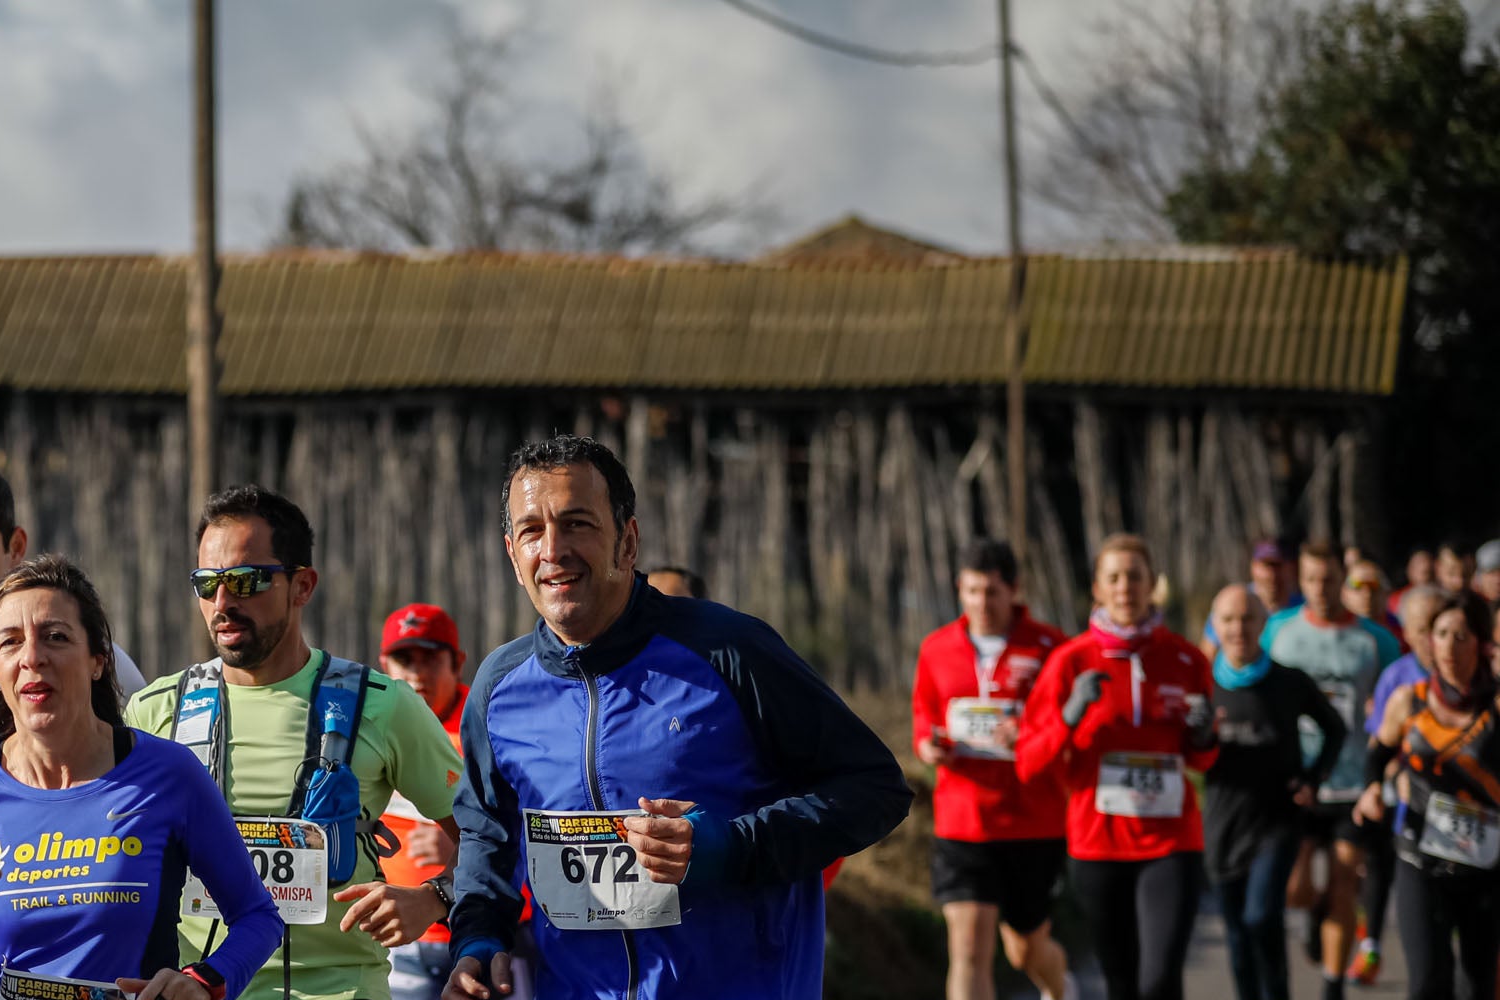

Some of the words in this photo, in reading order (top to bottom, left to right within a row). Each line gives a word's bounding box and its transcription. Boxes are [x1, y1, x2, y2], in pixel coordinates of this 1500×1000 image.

[235, 822, 277, 833] ARRERA
[531, 817, 541, 829] 26
[559, 817, 611, 828] CARRERA
[560, 826, 613, 834] POPULAR
[13, 831, 143, 864] olimpo
[561, 845, 639, 884] 672
[6, 864, 90, 884] deportes
[11, 896, 53, 911] TRAIL
[57, 894, 68, 906] &
[72, 891, 140, 905] RUNNING
[597, 908, 626, 918] olimpo
[7, 976, 18, 994] VII
[18, 978, 76, 995] CARRERA
